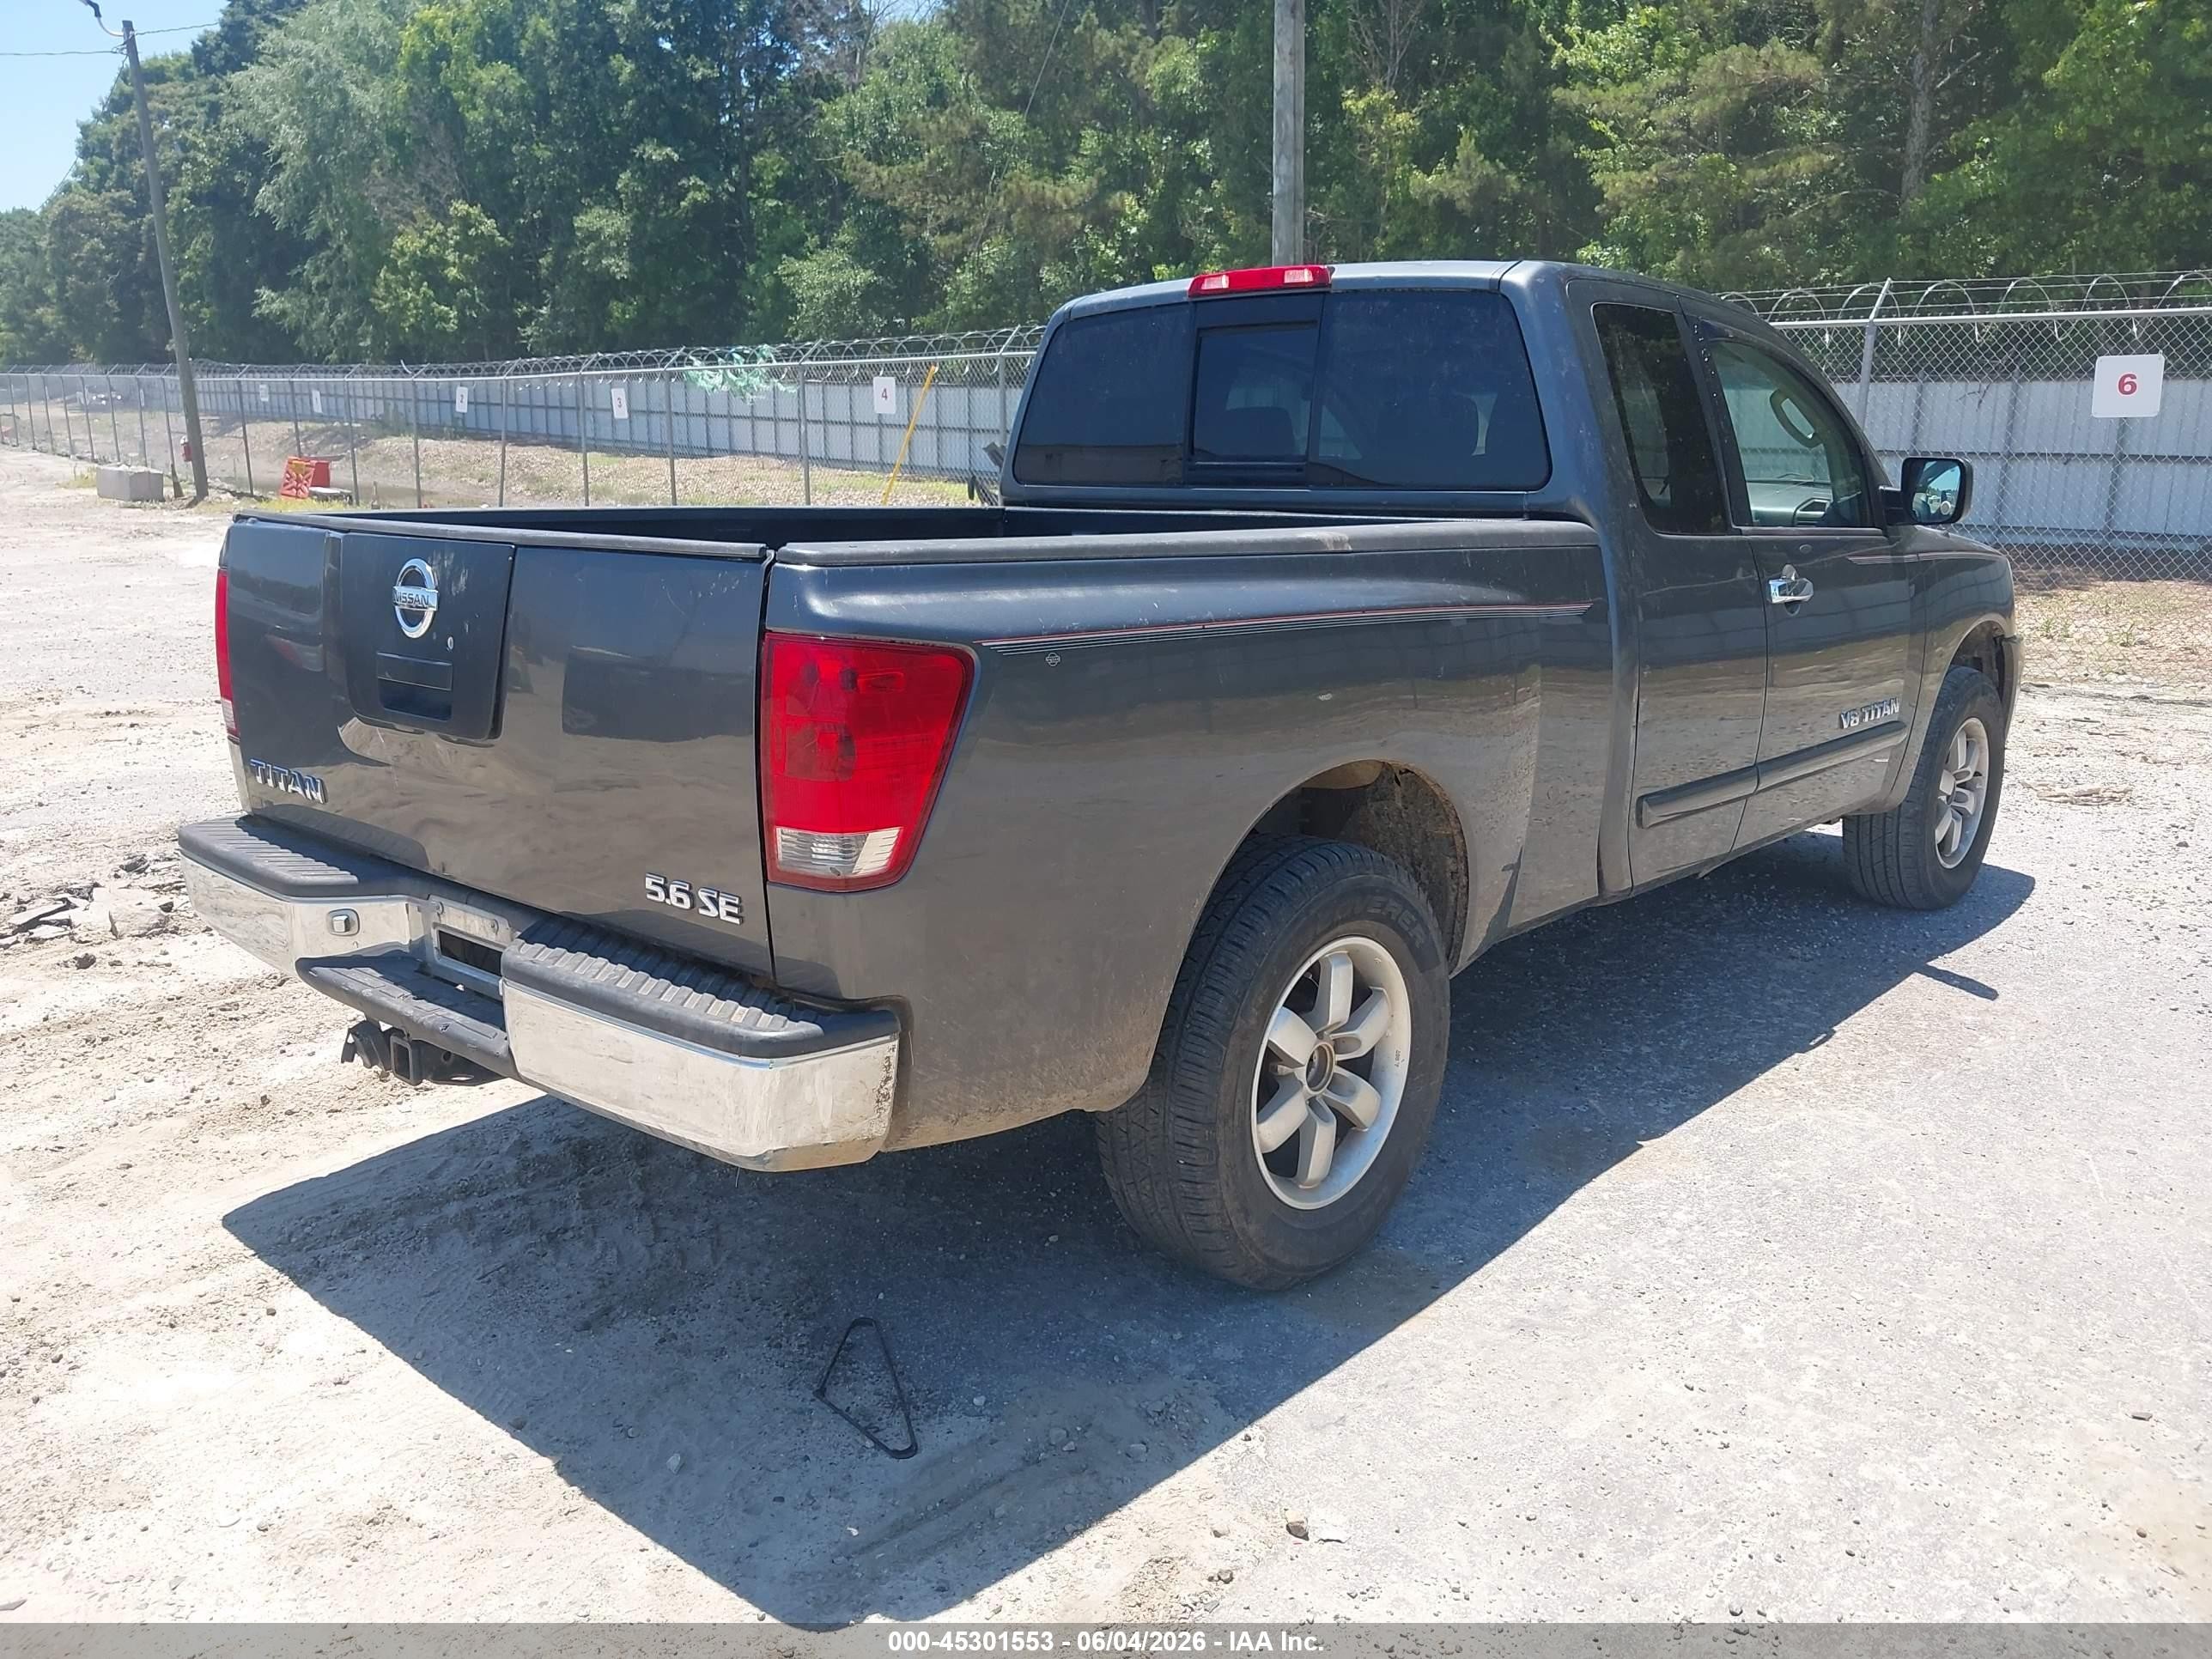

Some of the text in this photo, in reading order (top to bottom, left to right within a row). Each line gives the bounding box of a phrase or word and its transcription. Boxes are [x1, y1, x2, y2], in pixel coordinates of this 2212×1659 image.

[881, 387, 888, 401] 4
[2118, 373, 2137, 396] 6
[393, 590, 430, 607] NISSAN
[1840, 696, 1900, 729] V8 TITAN
[249, 758, 328, 805] TITAN
[645, 872, 744, 925] 5.6 SE
